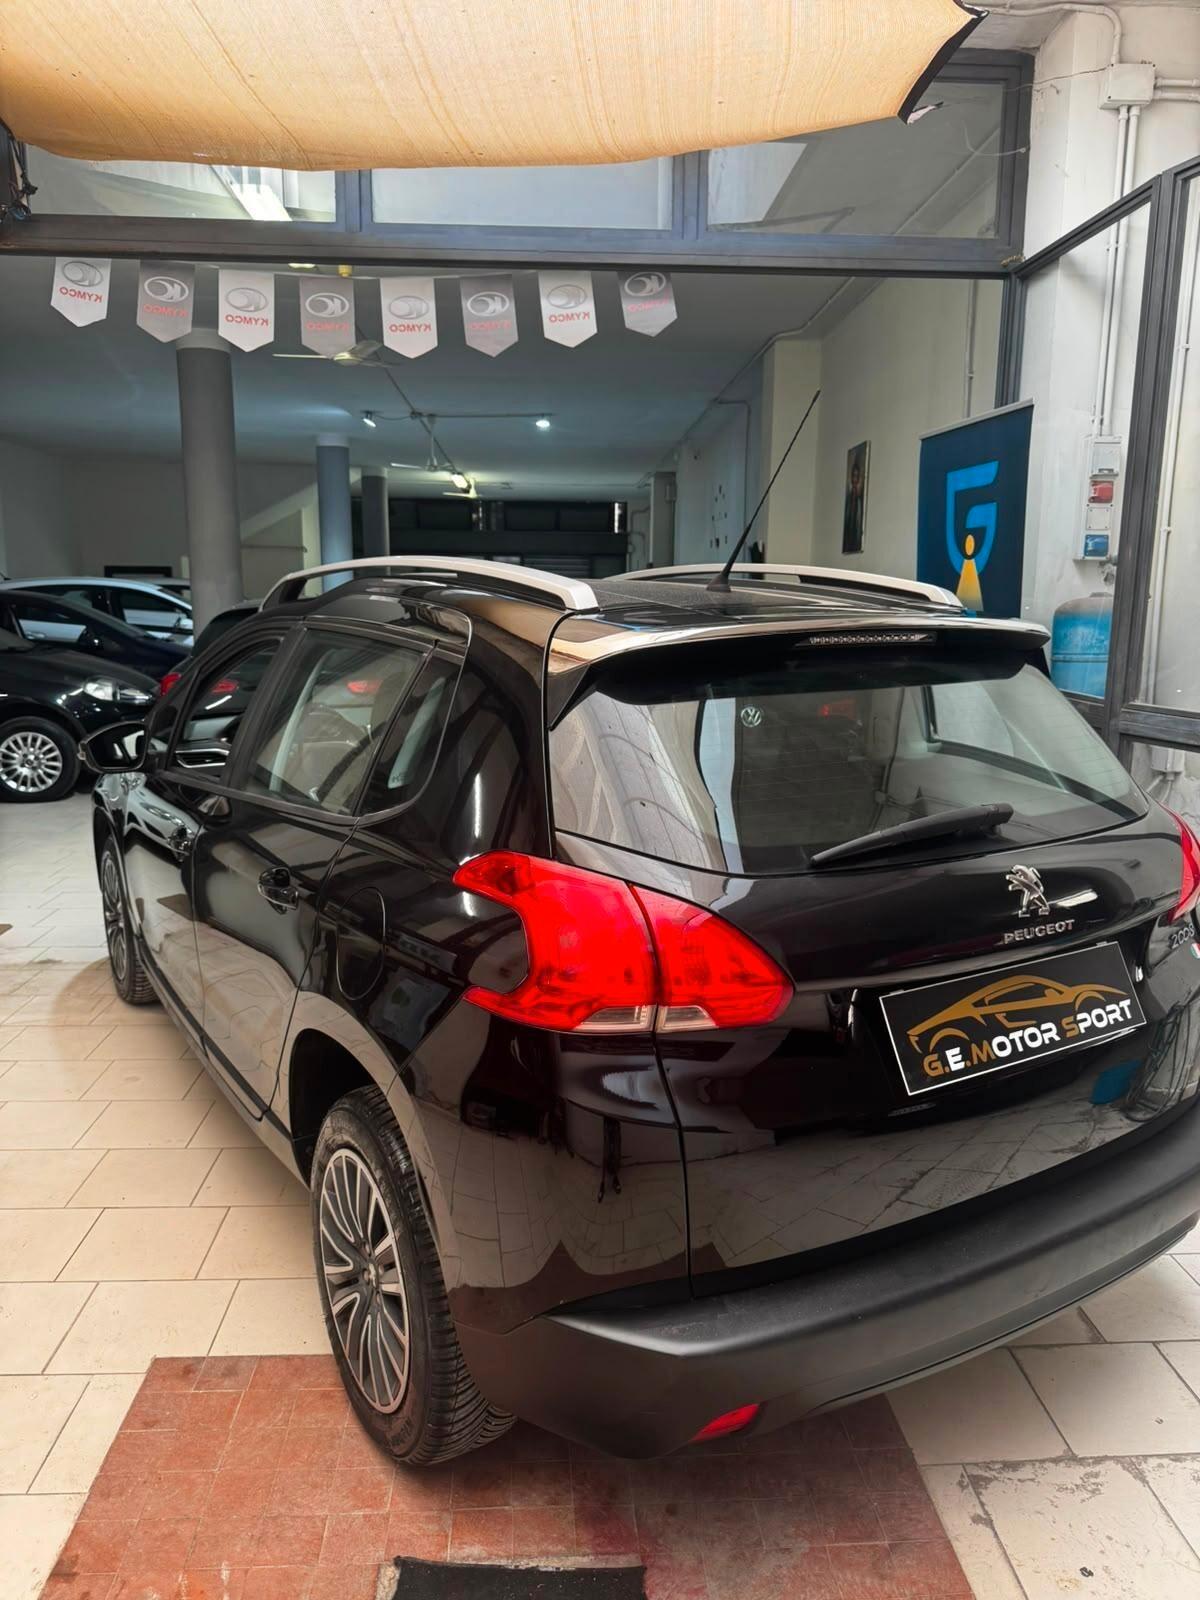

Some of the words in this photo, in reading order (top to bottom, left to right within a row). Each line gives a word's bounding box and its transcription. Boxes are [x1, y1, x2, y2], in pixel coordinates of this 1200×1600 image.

[1003, 919, 1074, 945] PEUGEOT
[1171, 922, 1195, 949] 2008
[1061, 999, 1132, 1038] SPORT
